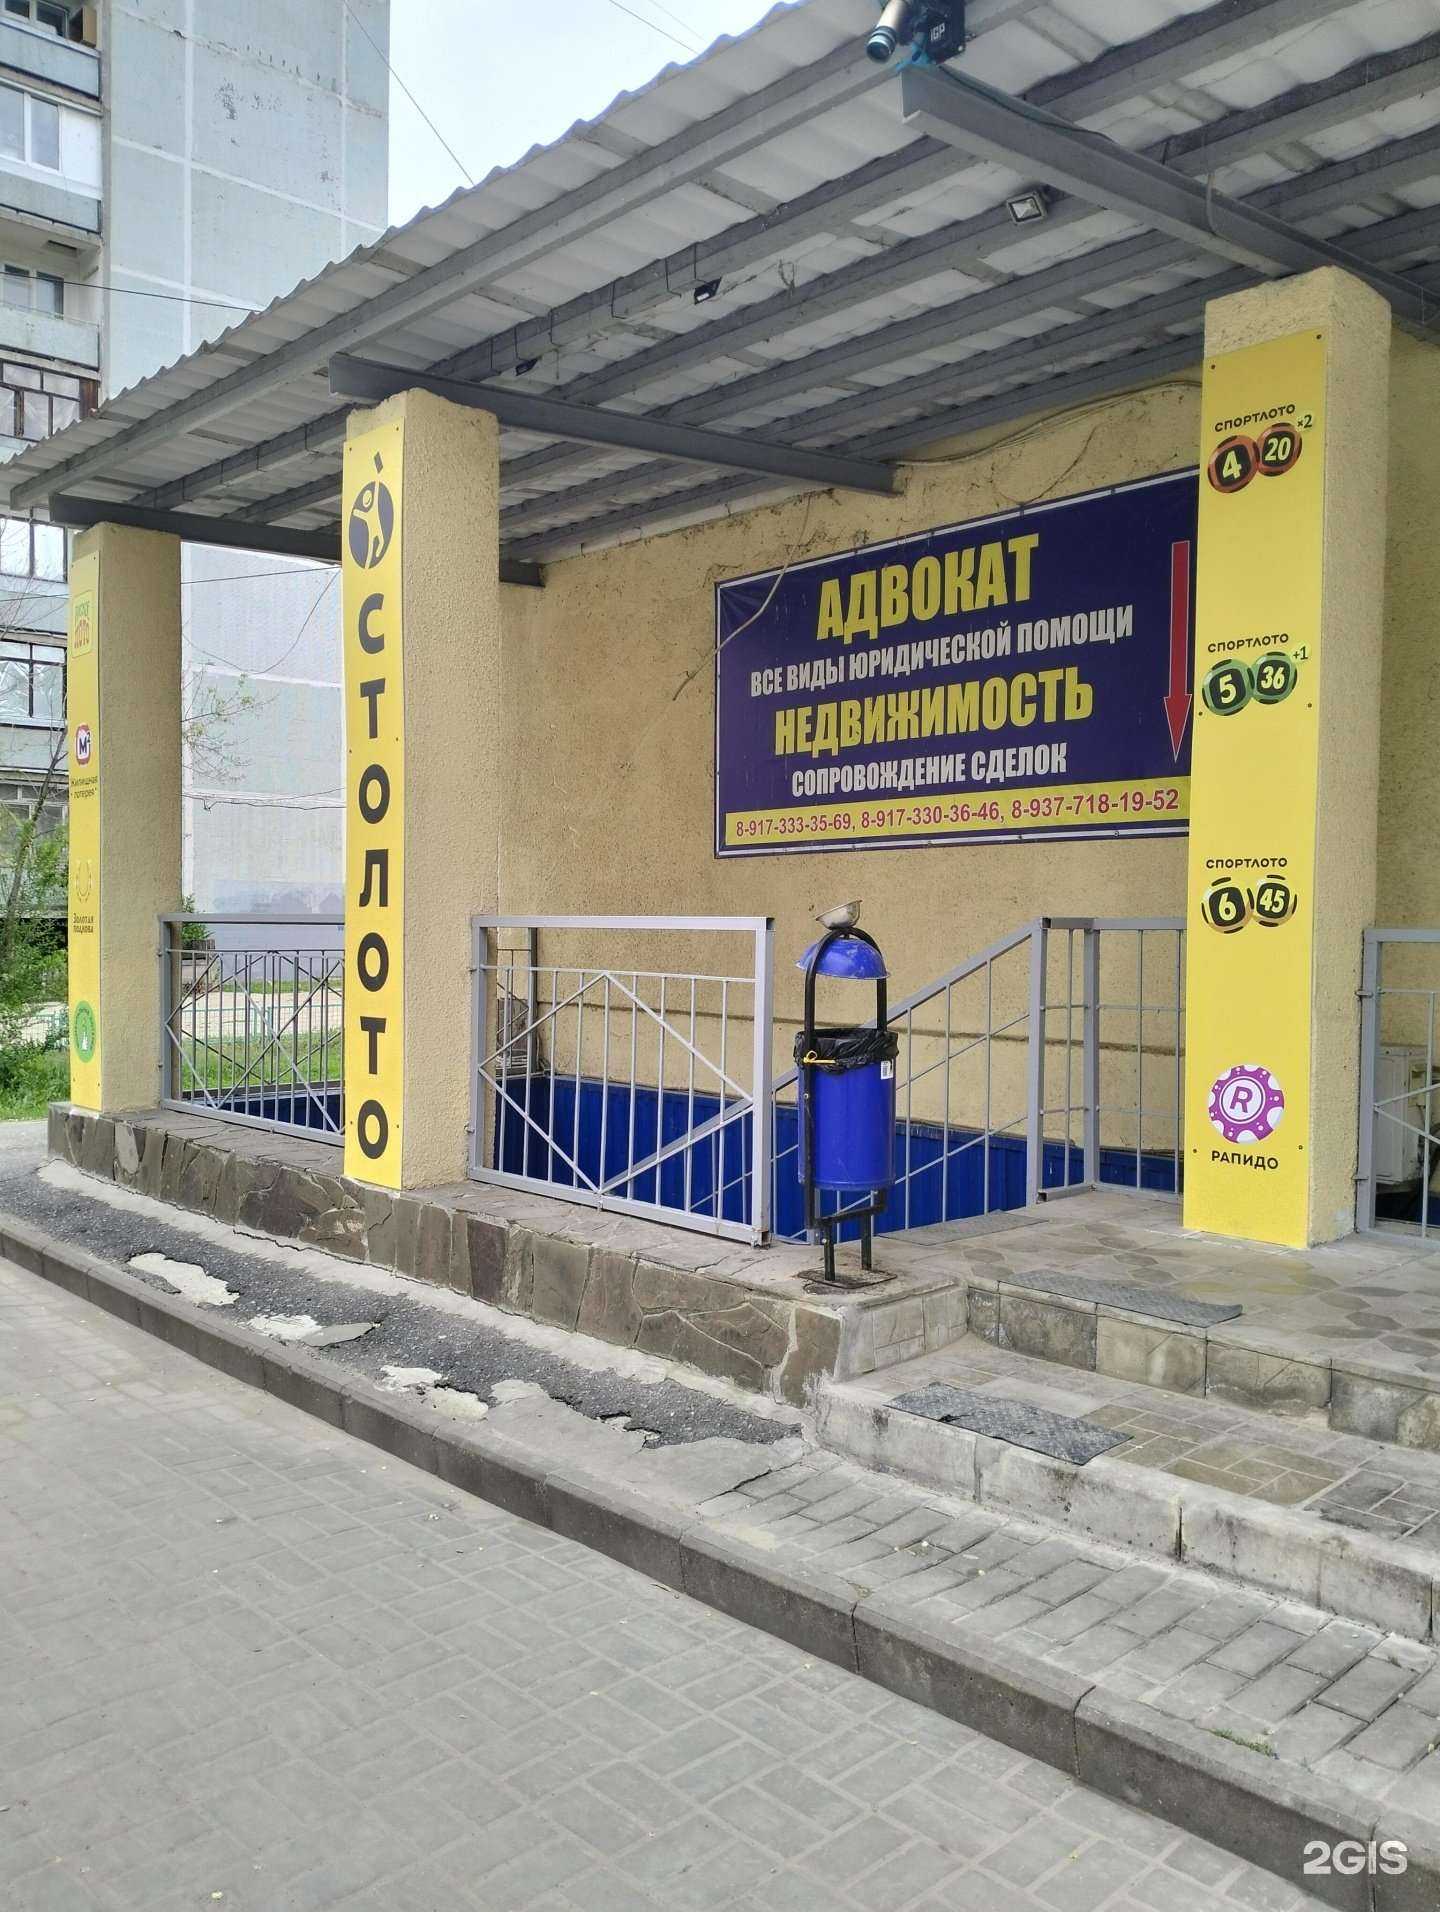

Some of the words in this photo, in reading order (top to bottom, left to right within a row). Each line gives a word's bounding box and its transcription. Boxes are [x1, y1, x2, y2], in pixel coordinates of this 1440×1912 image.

[1214, 404, 1295, 432] СПОРТЛОТО
[1222, 450, 1242, 480] 4
[1264, 437, 1291, 461] 20
[817, 533, 1039, 644] АДВОКАТ
[751, 671, 783, 697] ВСЕ
[787, 656, 845, 692] ВИДЫ
[849, 621, 1011, 678] ЮРИДИЧЕСКОЙ
[1017, 604, 1133, 654] ПОМОЩИ
[1207, 633, 1289, 654] СПОРТЛОТО
[1219, 674, 1236, 704] 5
[1261, 665, 1286, 691] 36
[775, 666, 1093, 759] НЕДВИЖИМОСТЬ
[792, 753, 966, 798] СОПРОВОЖДЕНИЕ
[971, 742, 1067, 784] СДЕЛОК
[736, 813, 856, 838] 8-917-333-35-69,
[861, 801, 1005, 829] 8-917-330-36-46,
[1011, 789, 1180, 820] 8-937-718-19-52
[357, 592, 390, 1160] СТОЛОТО
[1206, 857, 1288, 870] СПОРТЛОТО
[1218, 892, 1237, 921] 6
[1259, 888, 1285, 914] 45
[1229, 1086, 1253, 1113] R
[1211, 1150, 1279, 1171] РАПИДО
